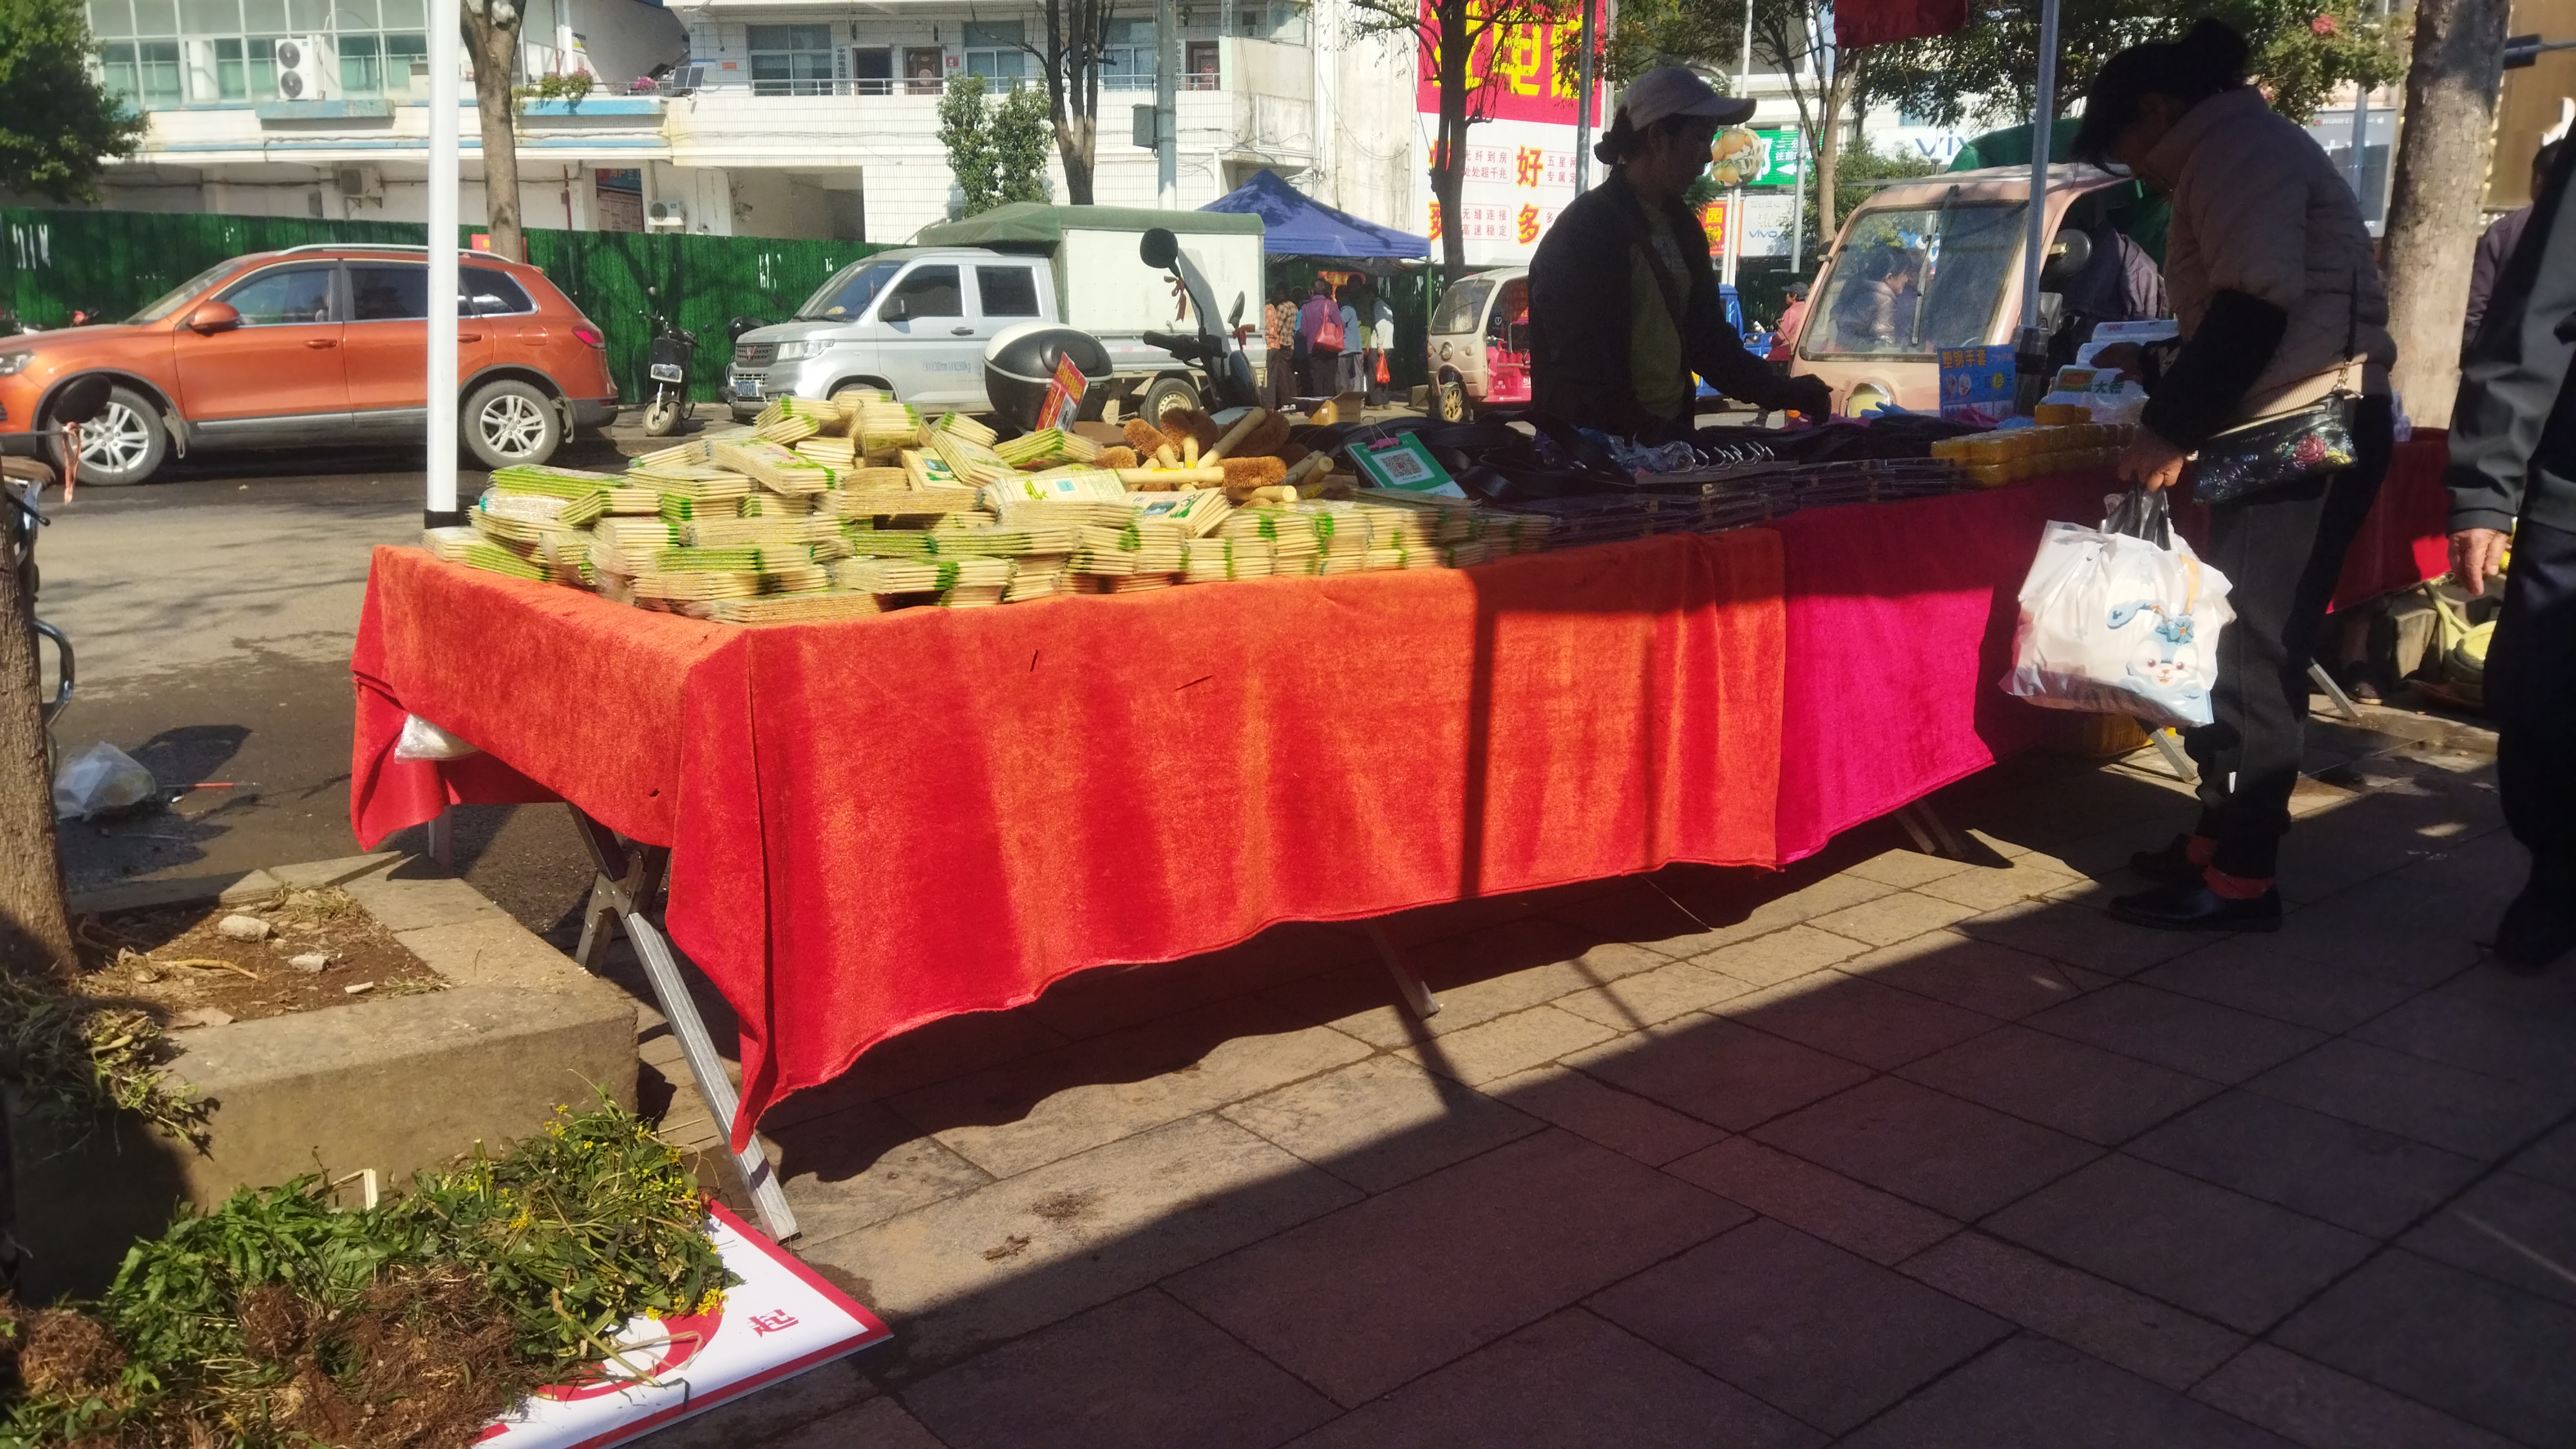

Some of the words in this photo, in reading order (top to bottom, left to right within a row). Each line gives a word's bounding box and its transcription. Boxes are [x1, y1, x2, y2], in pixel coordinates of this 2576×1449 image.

[1466, 149, 1507, 164] 光纤到房
[1463, 165, 1508, 179] 处处超千兆
[1517, 145, 1543, 189] 好
[1463, 208, 1507, 221] 无缝连接
[1461, 223, 1507, 236] 高速稳定
[1517, 202, 1542, 245] 多
[1748, 229, 1777, 238] vivo
[748, 1309, 799, 1338] 起
